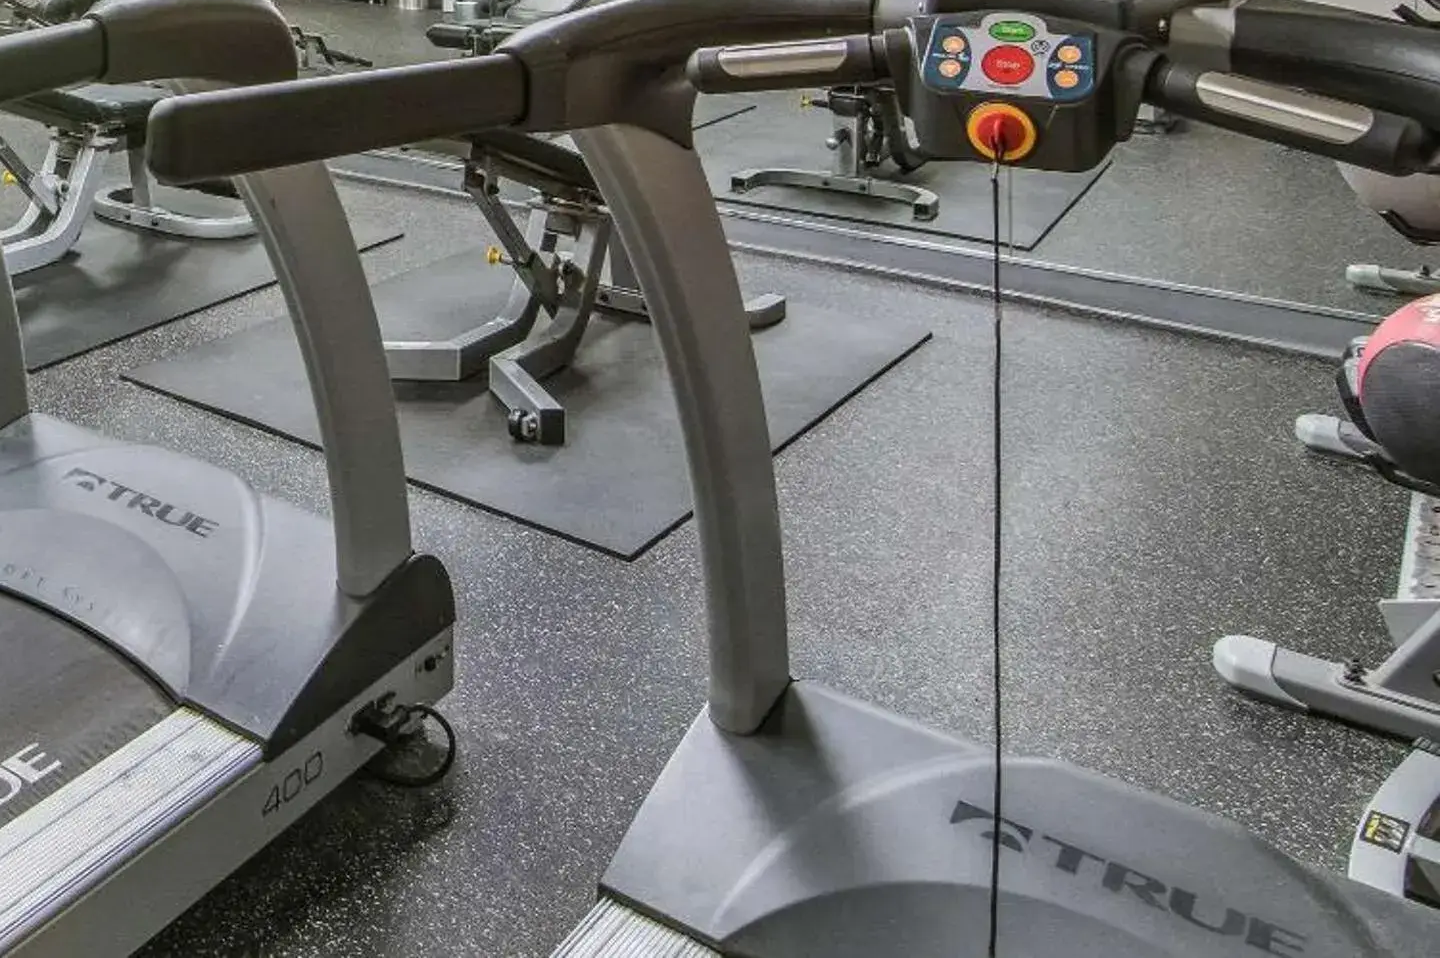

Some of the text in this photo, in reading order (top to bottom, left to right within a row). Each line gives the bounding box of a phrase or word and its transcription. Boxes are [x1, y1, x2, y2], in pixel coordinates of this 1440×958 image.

[101, 480, 220, 539] TRUE
[262, 751, 323, 818] 400
[1041, 834, 1308, 958] TRUE
